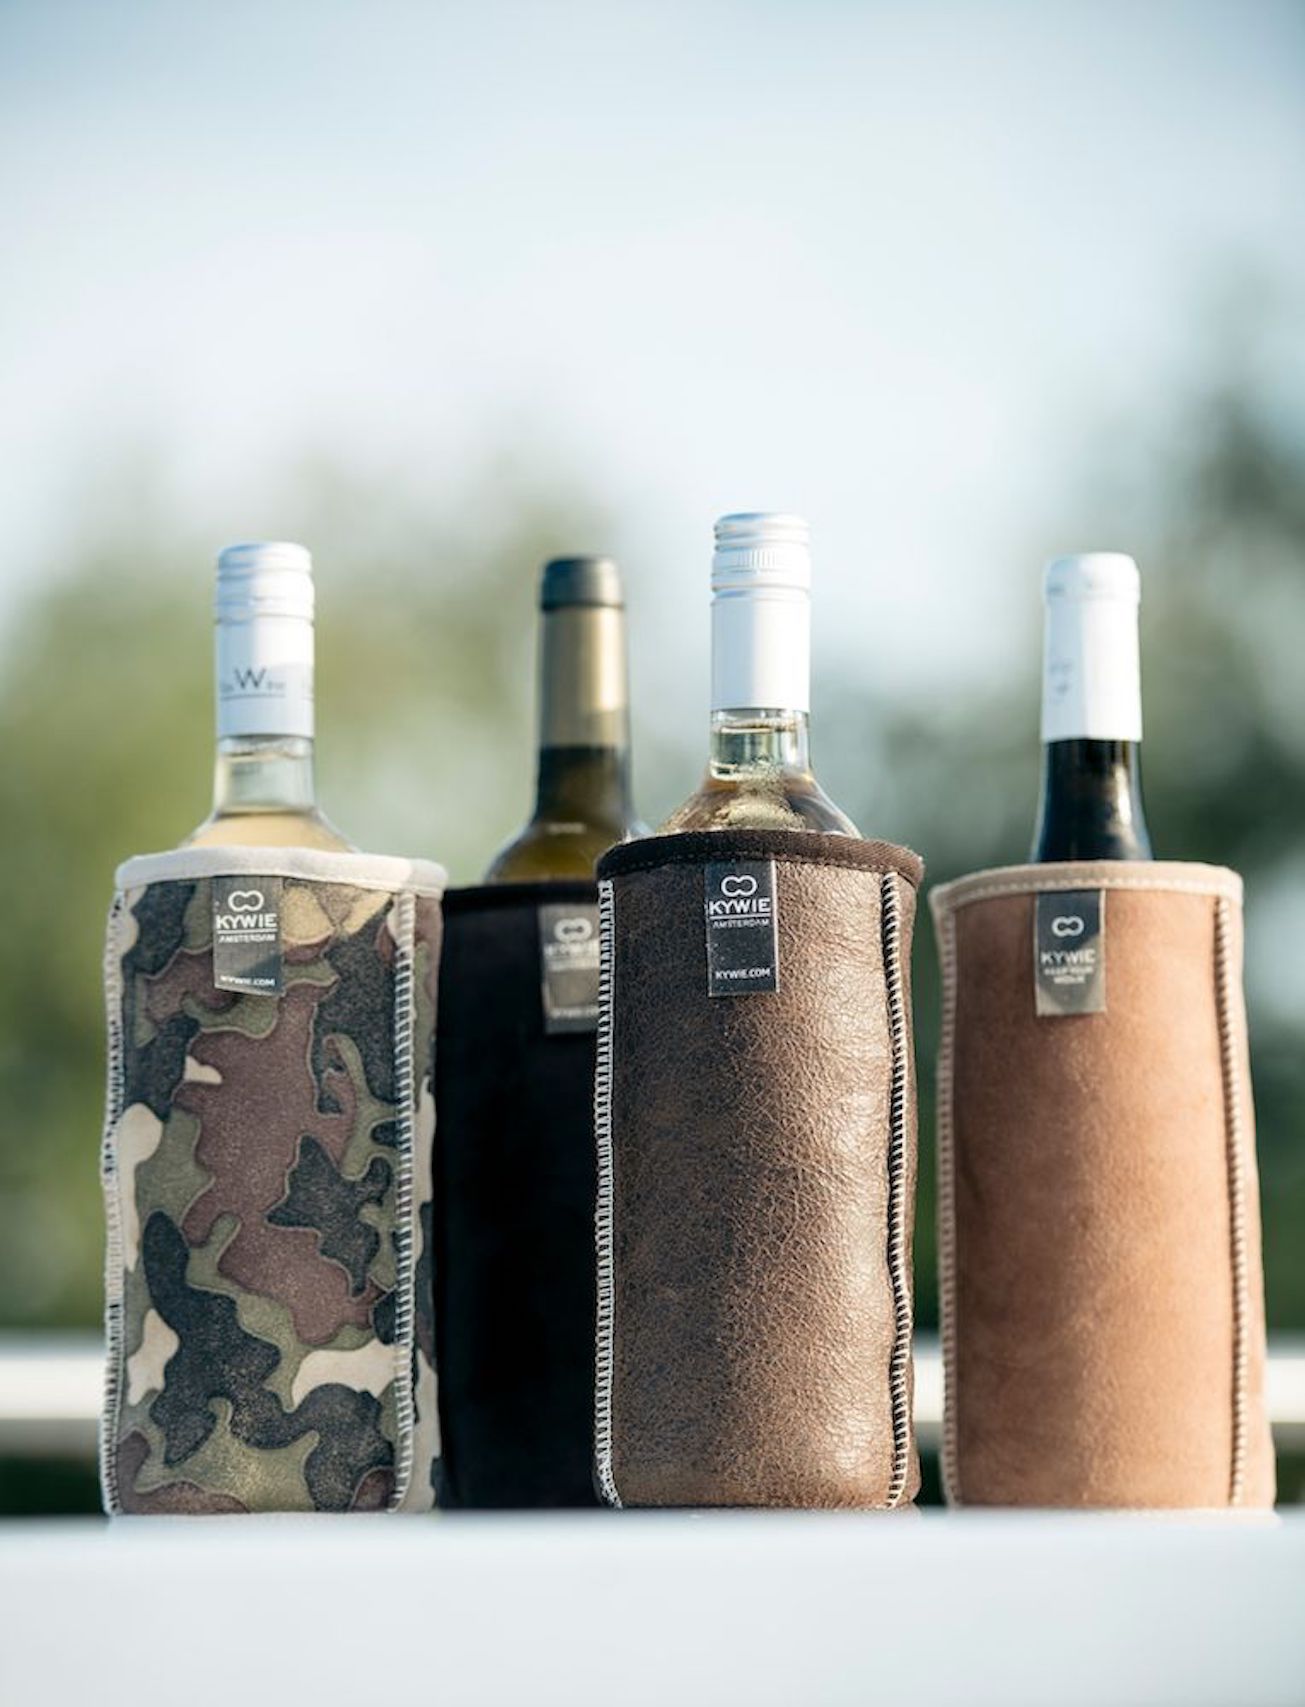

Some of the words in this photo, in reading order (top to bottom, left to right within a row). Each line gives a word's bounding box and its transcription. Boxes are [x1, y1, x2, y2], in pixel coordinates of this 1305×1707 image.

[708, 897, 772, 915] KYWIE
[215, 913, 278, 930] KYWIE
[712, 918, 770, 929] AMSTERDAM
[218, 933, 277, 944] AMSTERDAM
[715, 967, 771, 980] KYWIE.COM
